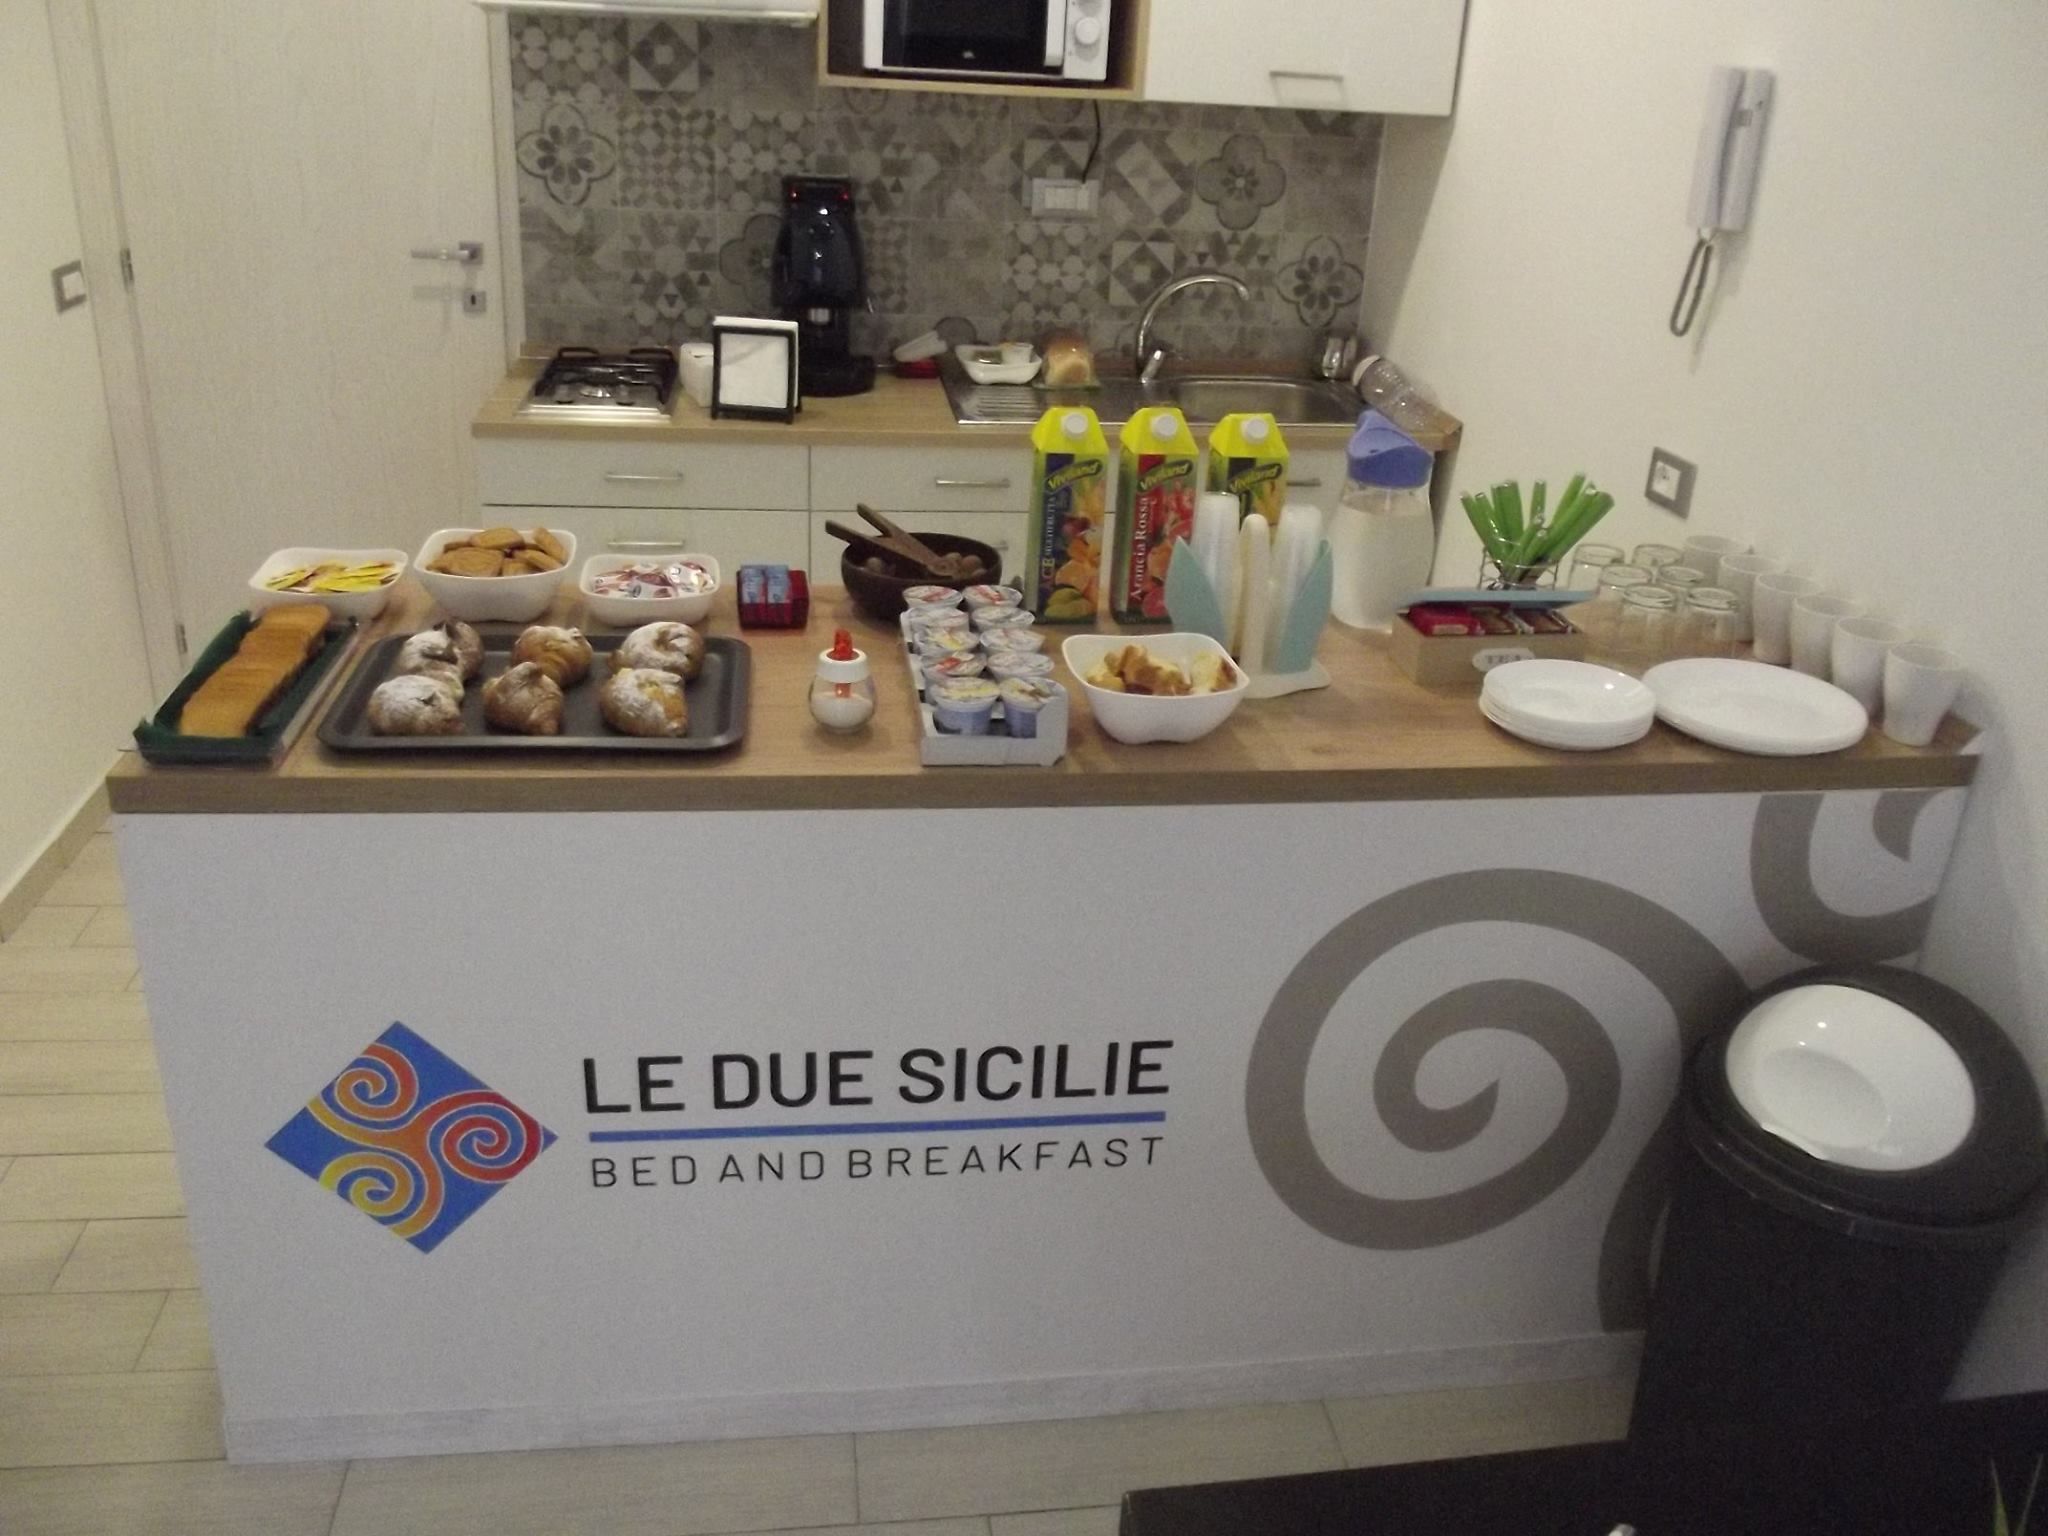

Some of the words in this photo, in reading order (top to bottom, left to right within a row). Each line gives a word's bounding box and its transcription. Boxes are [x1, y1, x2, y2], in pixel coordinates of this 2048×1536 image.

[1133, 497, 1150, 541] Rossa
[1130, 543, 1146, 601] Arancia
[583, 1055, 685, 1113] LE
[712, 1050, 873, 1109] DUE
[899, 1040, 1174, 1104] SICILIE
[592, 1155, 697, 1187] BED
[719, 1151, 824, 1182] AND
[848, 1136, 1164, 1178] BREAKFAST
